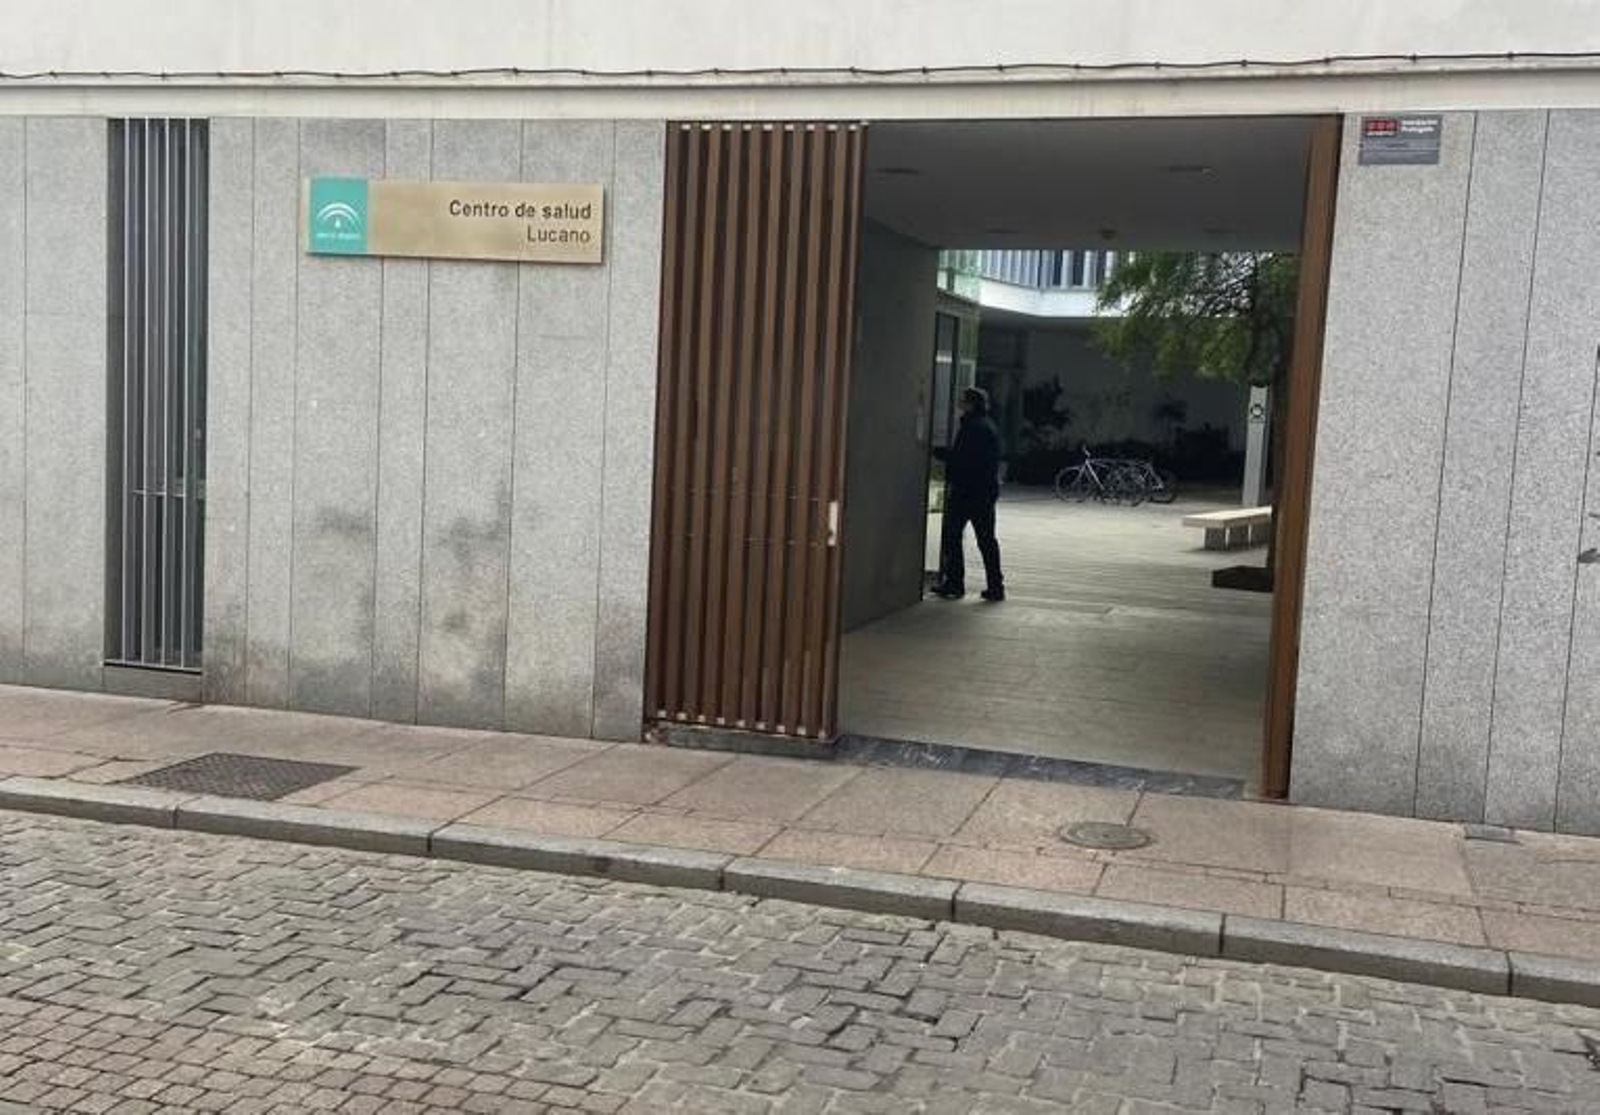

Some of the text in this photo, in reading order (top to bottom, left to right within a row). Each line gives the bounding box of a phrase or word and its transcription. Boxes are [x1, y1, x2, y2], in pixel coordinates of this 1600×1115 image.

[449, 199, 591, 220] Centro de salud
[527, 225, 591, 244] Lucano
